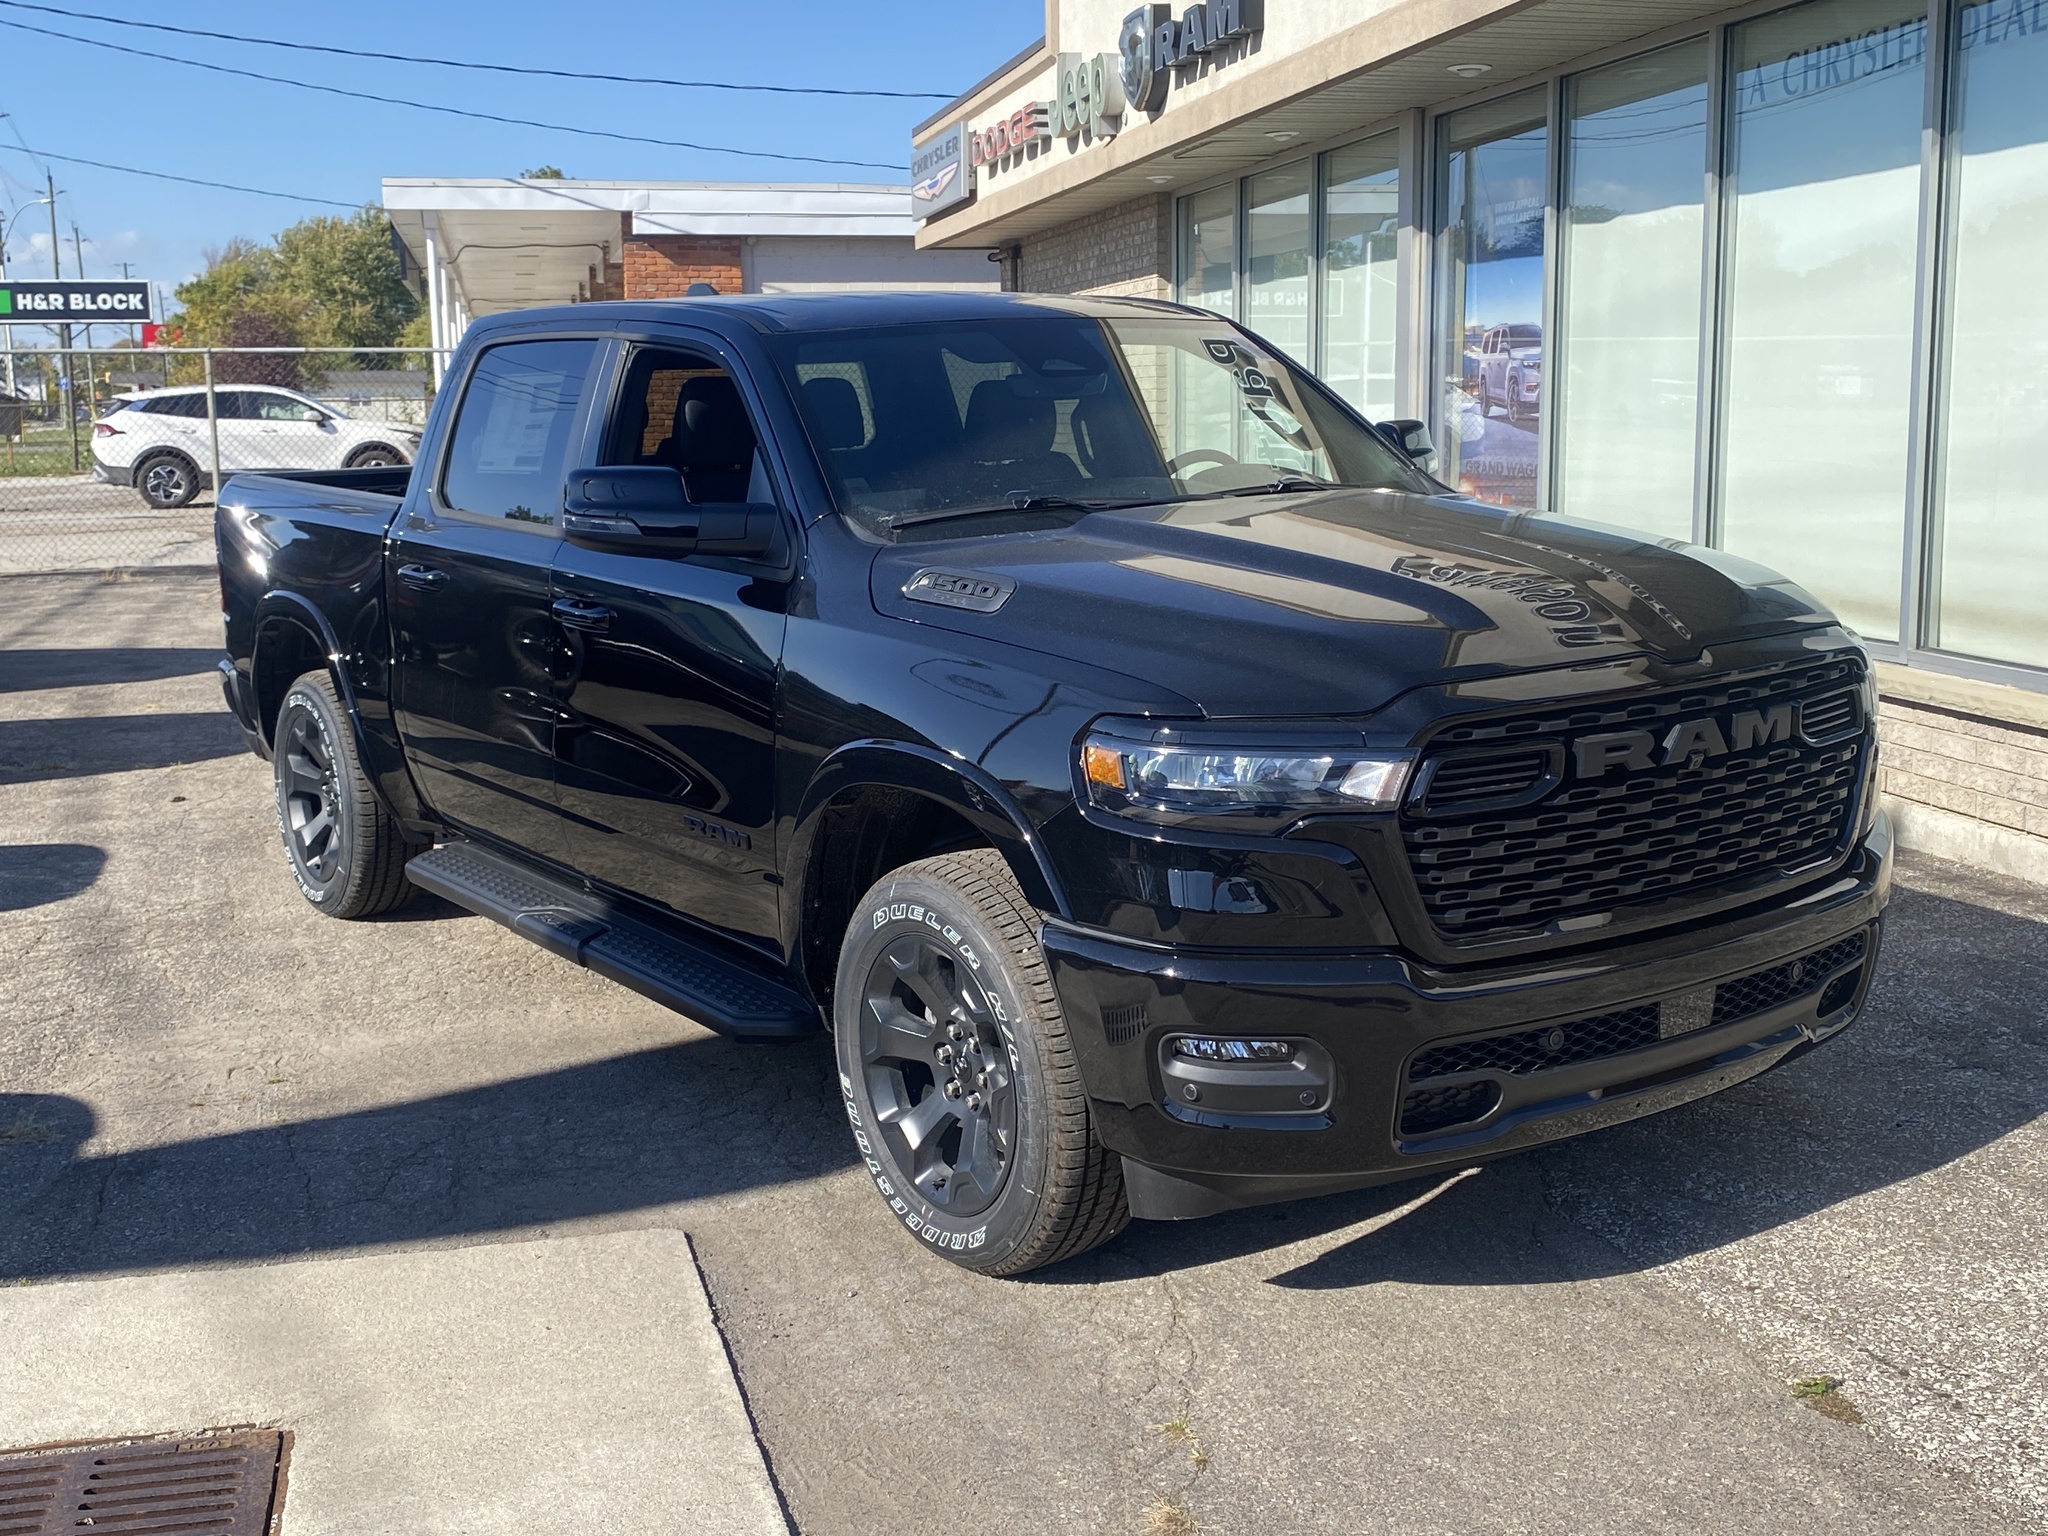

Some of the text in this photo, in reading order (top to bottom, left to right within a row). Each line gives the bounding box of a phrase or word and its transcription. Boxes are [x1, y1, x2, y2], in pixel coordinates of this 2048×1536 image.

[1154, 0, 1250, 72] RAM
[1750, 61, 1767, 106] A
[1782, 15, 1927, 96] CHRYSLER
[1048, 52, 1114, 138] Jeep
[911, 135, 960, 178] CHRYSLER
[971, 102, 1042, 167] DODGE
[16, 293, 144, 311] H&R BLOCK
[1465, 459, 1504, 476] GRAND
[918, 573, 999, 599] 1500
[1572, 703, 1793, 780] RAM
[683, 814, 752, 850] RAM
[872, 903, 981, 971] DUELER
[839, 1072, 986, 1250] BRIDGESTONE
